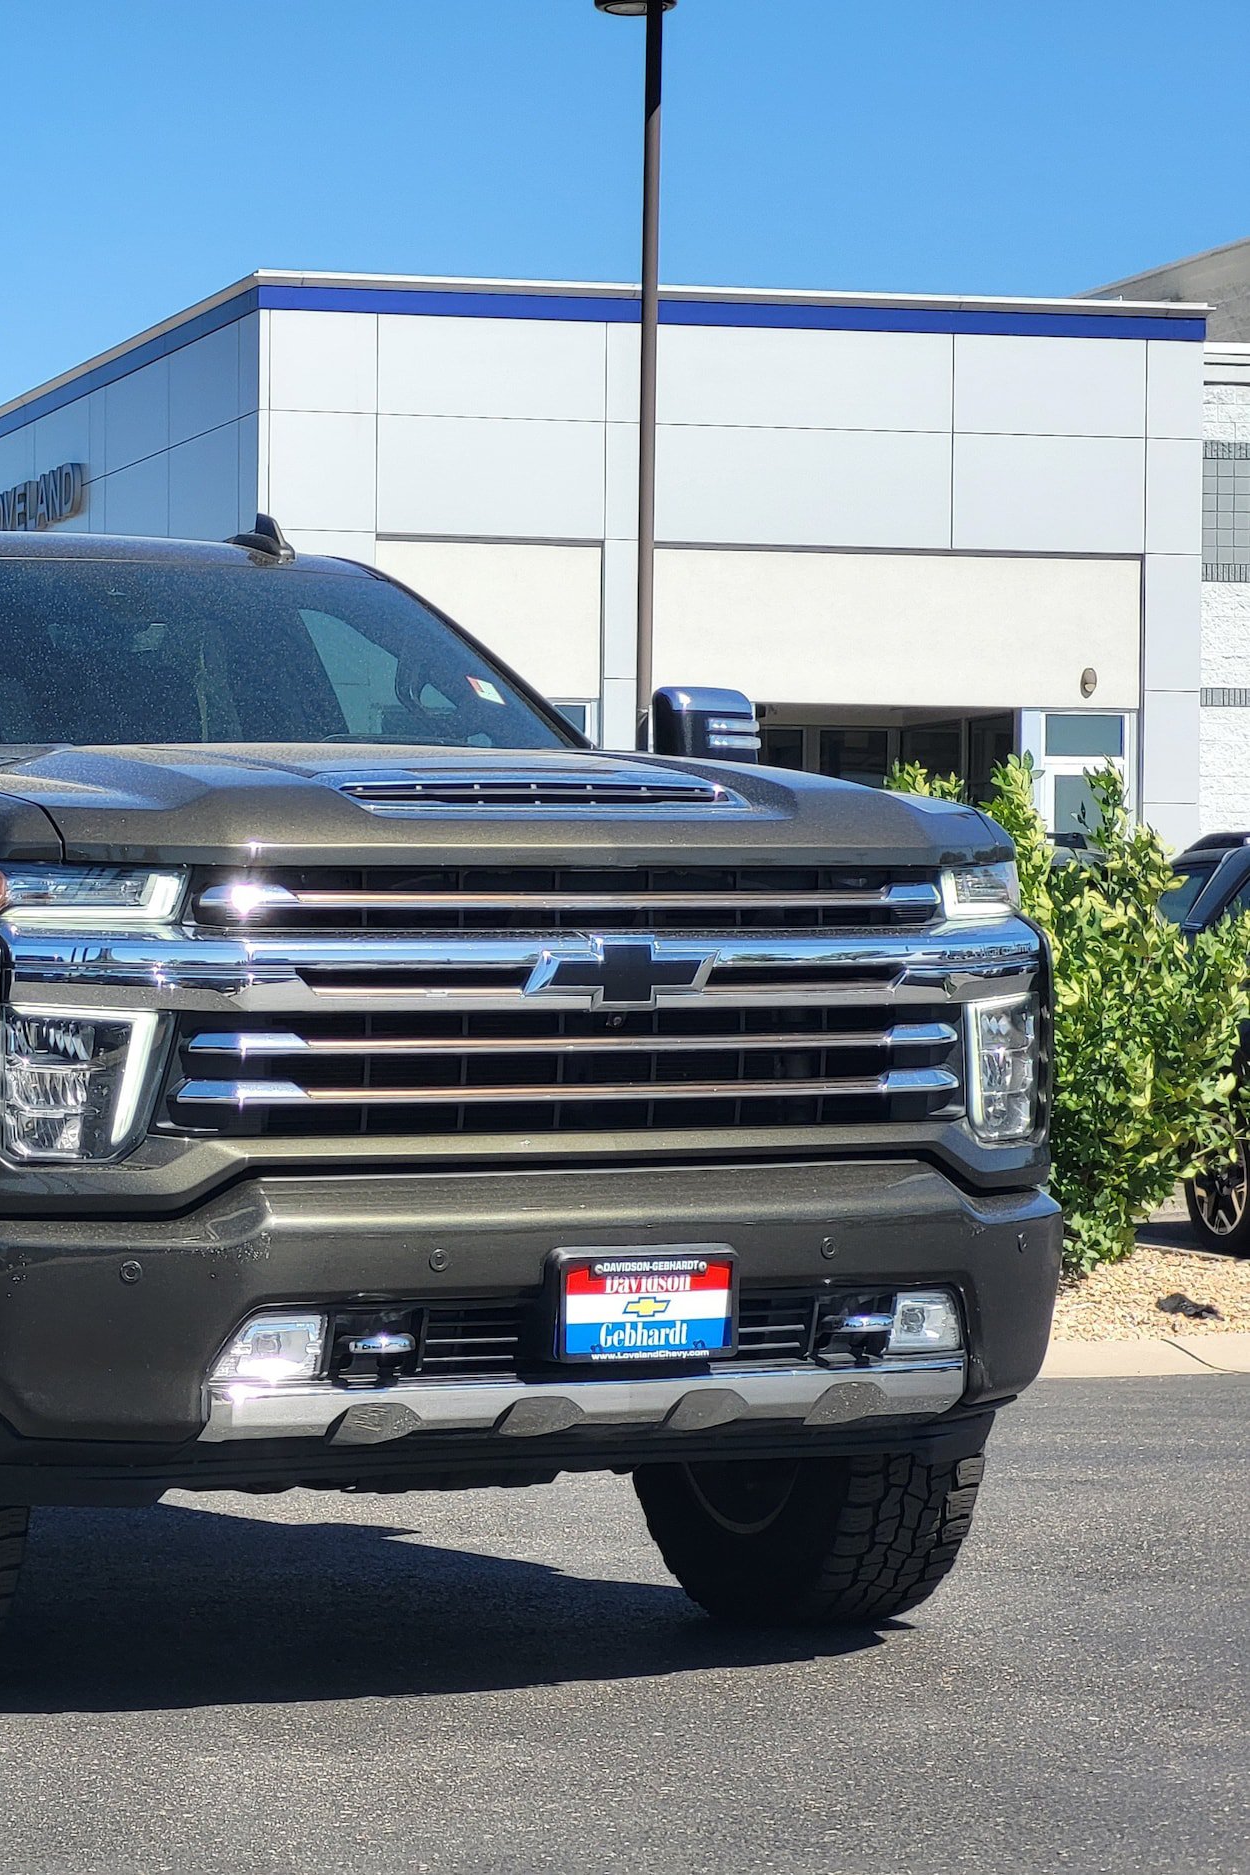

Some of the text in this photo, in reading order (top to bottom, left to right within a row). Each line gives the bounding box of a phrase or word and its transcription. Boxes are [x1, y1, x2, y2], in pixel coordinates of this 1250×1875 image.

[602, 1260, 699, 1272] DAVIDSON-GEBHARDT
[604, 1274, 692, 1293] Davidson
[599, 1320, 688, 1348] Gebhardt
[591, 1350, 710, 1360] www.LovelandChevy.com
